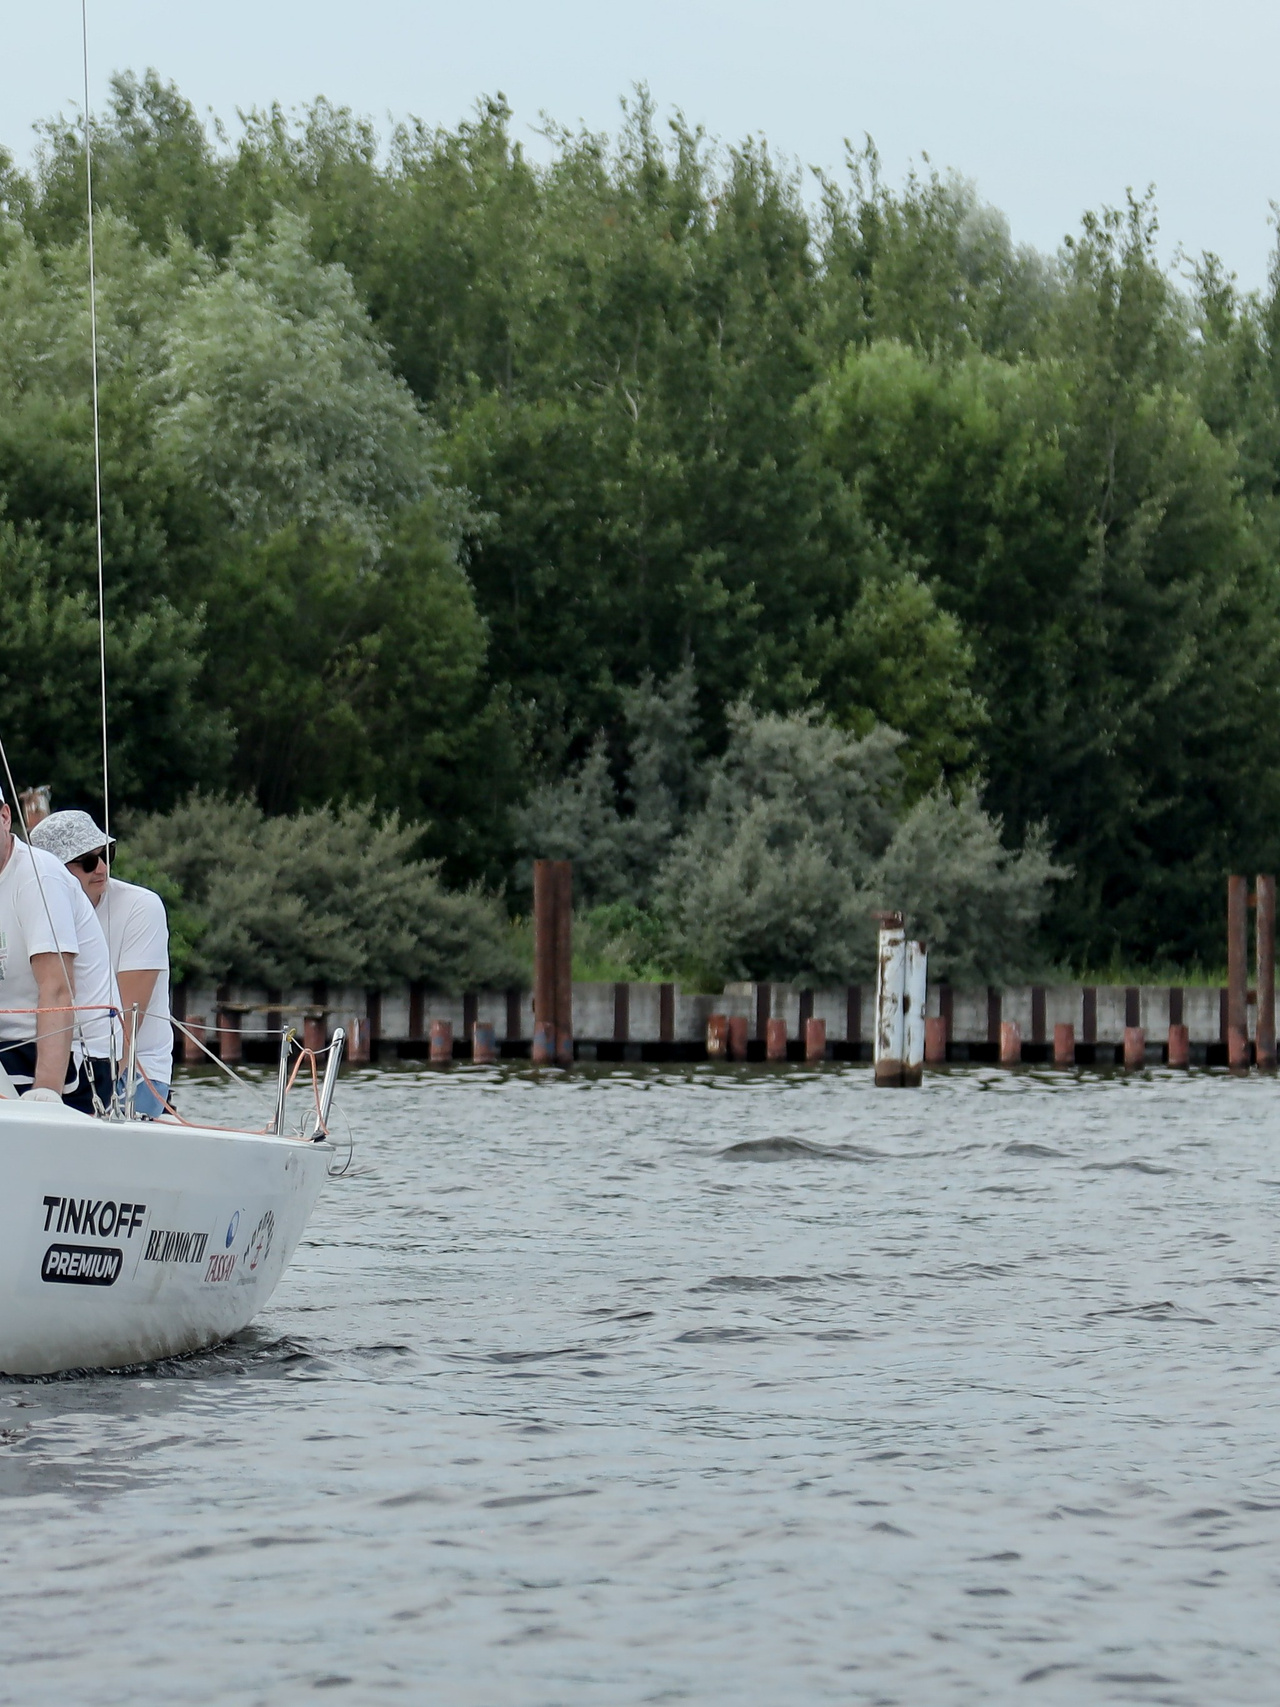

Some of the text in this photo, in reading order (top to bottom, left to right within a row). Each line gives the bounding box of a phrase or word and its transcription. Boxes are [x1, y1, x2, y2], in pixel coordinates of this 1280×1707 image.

[43, 1196, 146, 1239] TINKOFF
[45, 1250, 119, 1279] PREMIUM
[204, 1254, 237, 1282] TASSAY
